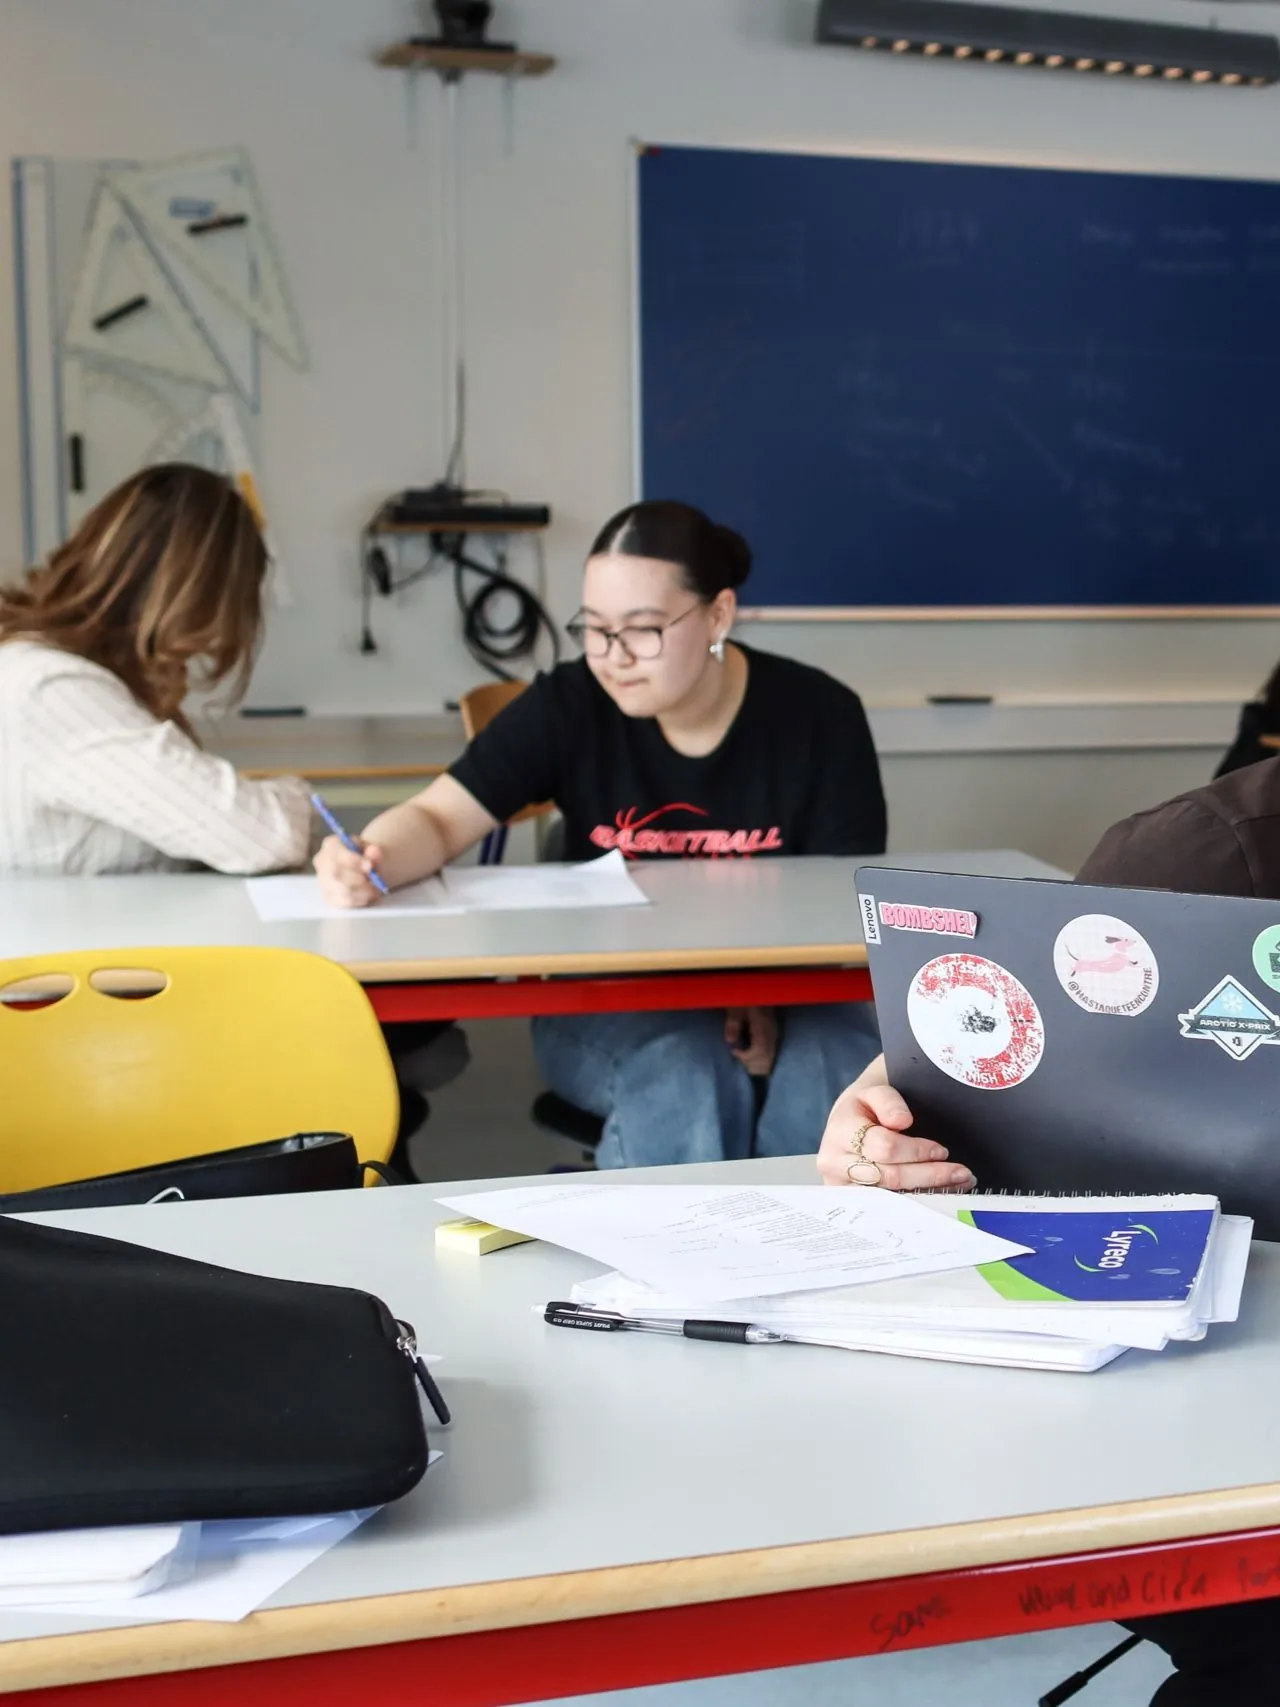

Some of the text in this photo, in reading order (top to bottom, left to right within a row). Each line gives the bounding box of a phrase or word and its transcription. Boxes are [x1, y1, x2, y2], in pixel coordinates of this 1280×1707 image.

[589, 825, 783, 853] BASKETBALL
[864, 898, 877, 940] Lenovo
[1200, 1019, 1237, 1028] ARCTIC
[1098, 1230, 1142, 1269] Lyreco
